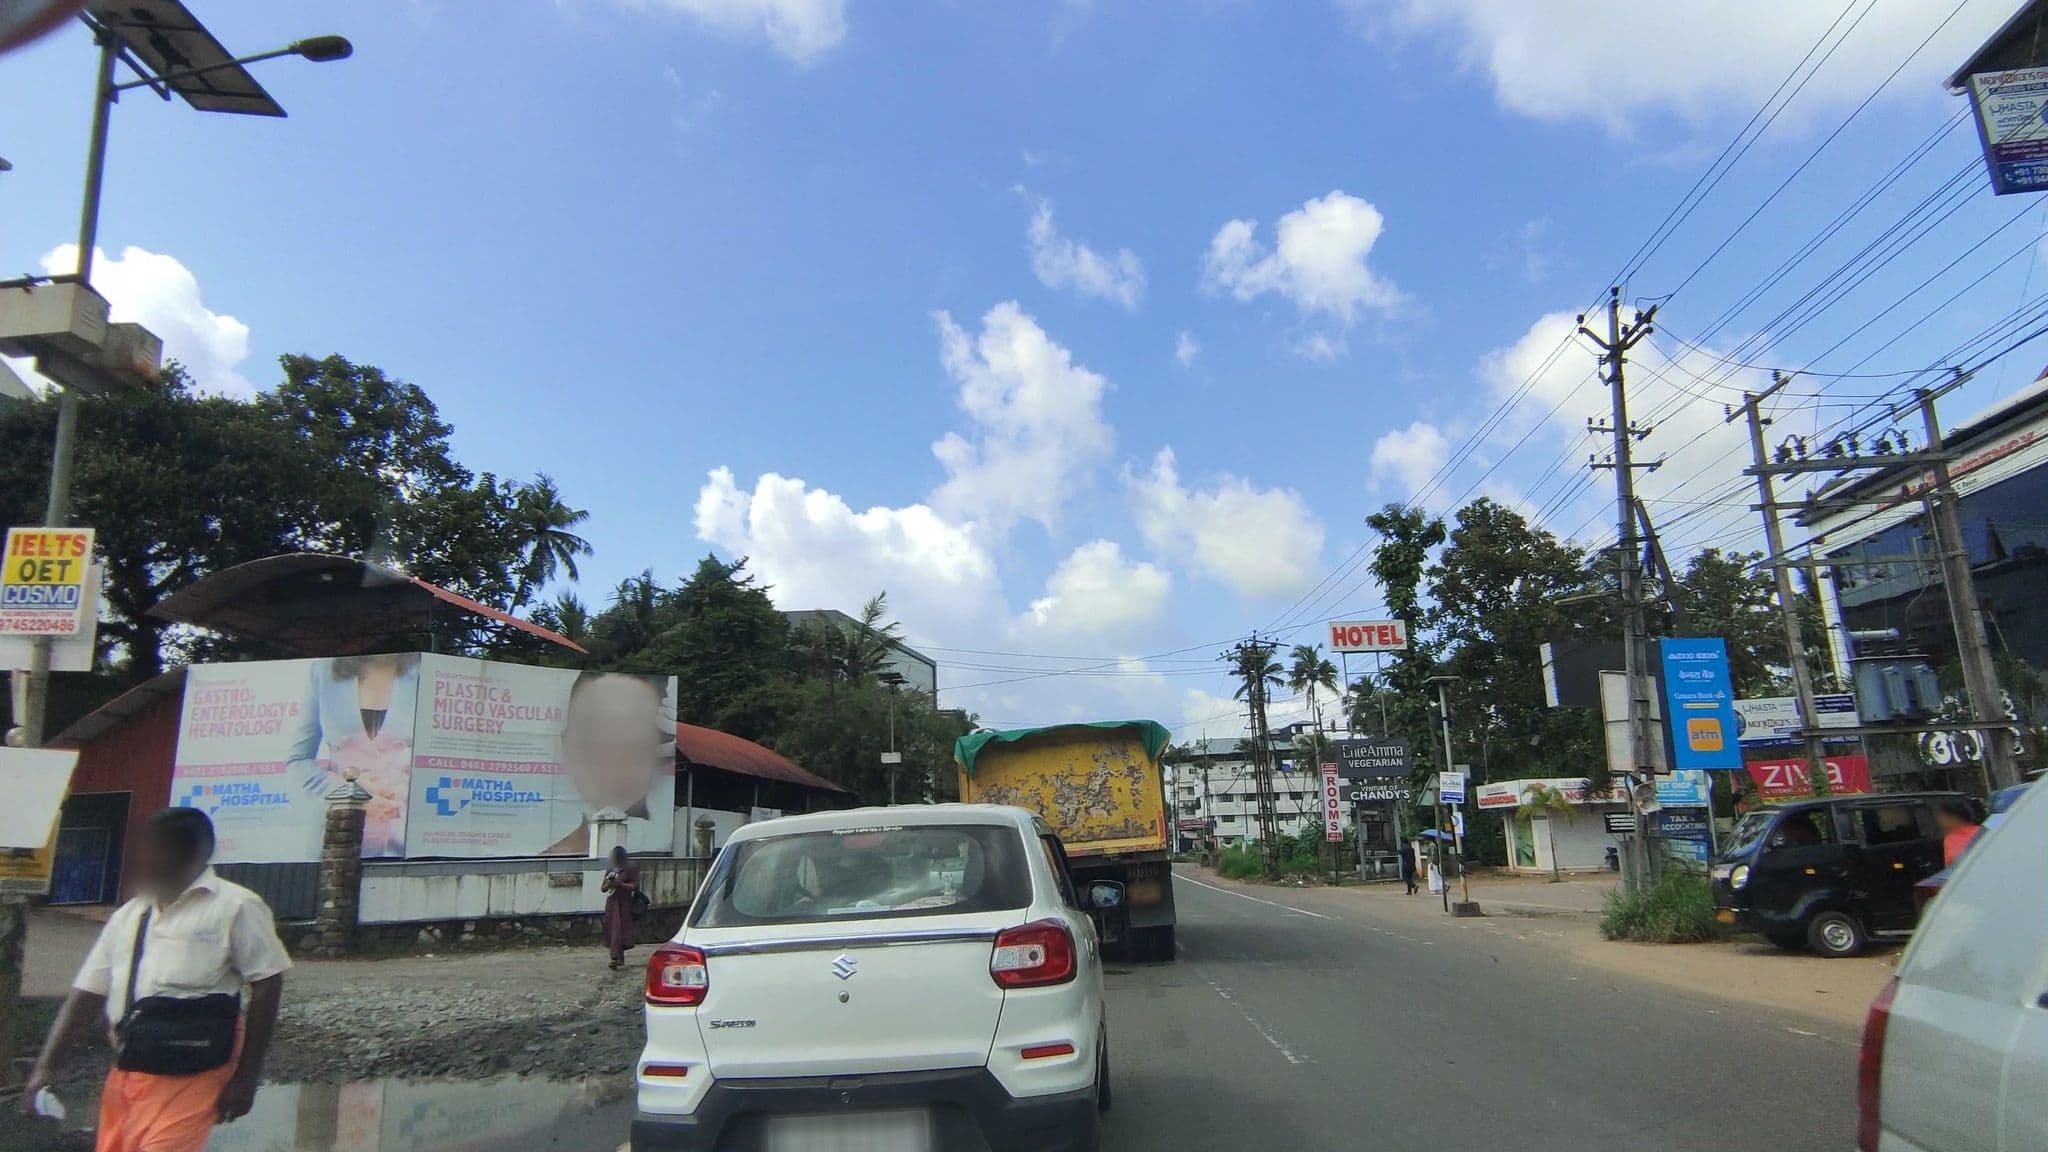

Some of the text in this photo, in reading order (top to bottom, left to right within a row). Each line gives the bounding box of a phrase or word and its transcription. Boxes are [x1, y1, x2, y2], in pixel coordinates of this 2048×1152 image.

[12, 534, 87, 556] IELTS
[19, 559, 72, 581] OET
[4, 585, 78, 603] COSMO
[1331, 625, 1403, 646] HOTEL
[435, 681, 512, 702] PLASTIC &
[433, 698, 561, 721] MICRO VASCULAR
[188, 720, 282, 738] HEPATOLOGY
[432, 714, 505, 734] SURGERY
[1692, 730, 1719, 740] atm
[1348, 758, 1403, 768] VEGETARIAN
[213, 784, 260, 795] MATHA
[462, 778, 513, 791] MATHA
[221, 794, 289, 806] HOSPITAL
[471, 791, 544, 802] HOSPITAL
[1327, 776, 1339, 831] ROOMS
[1350, 789, 1410, 801] CHANDY'S
[1669, 815, 1688, 823] TAX
